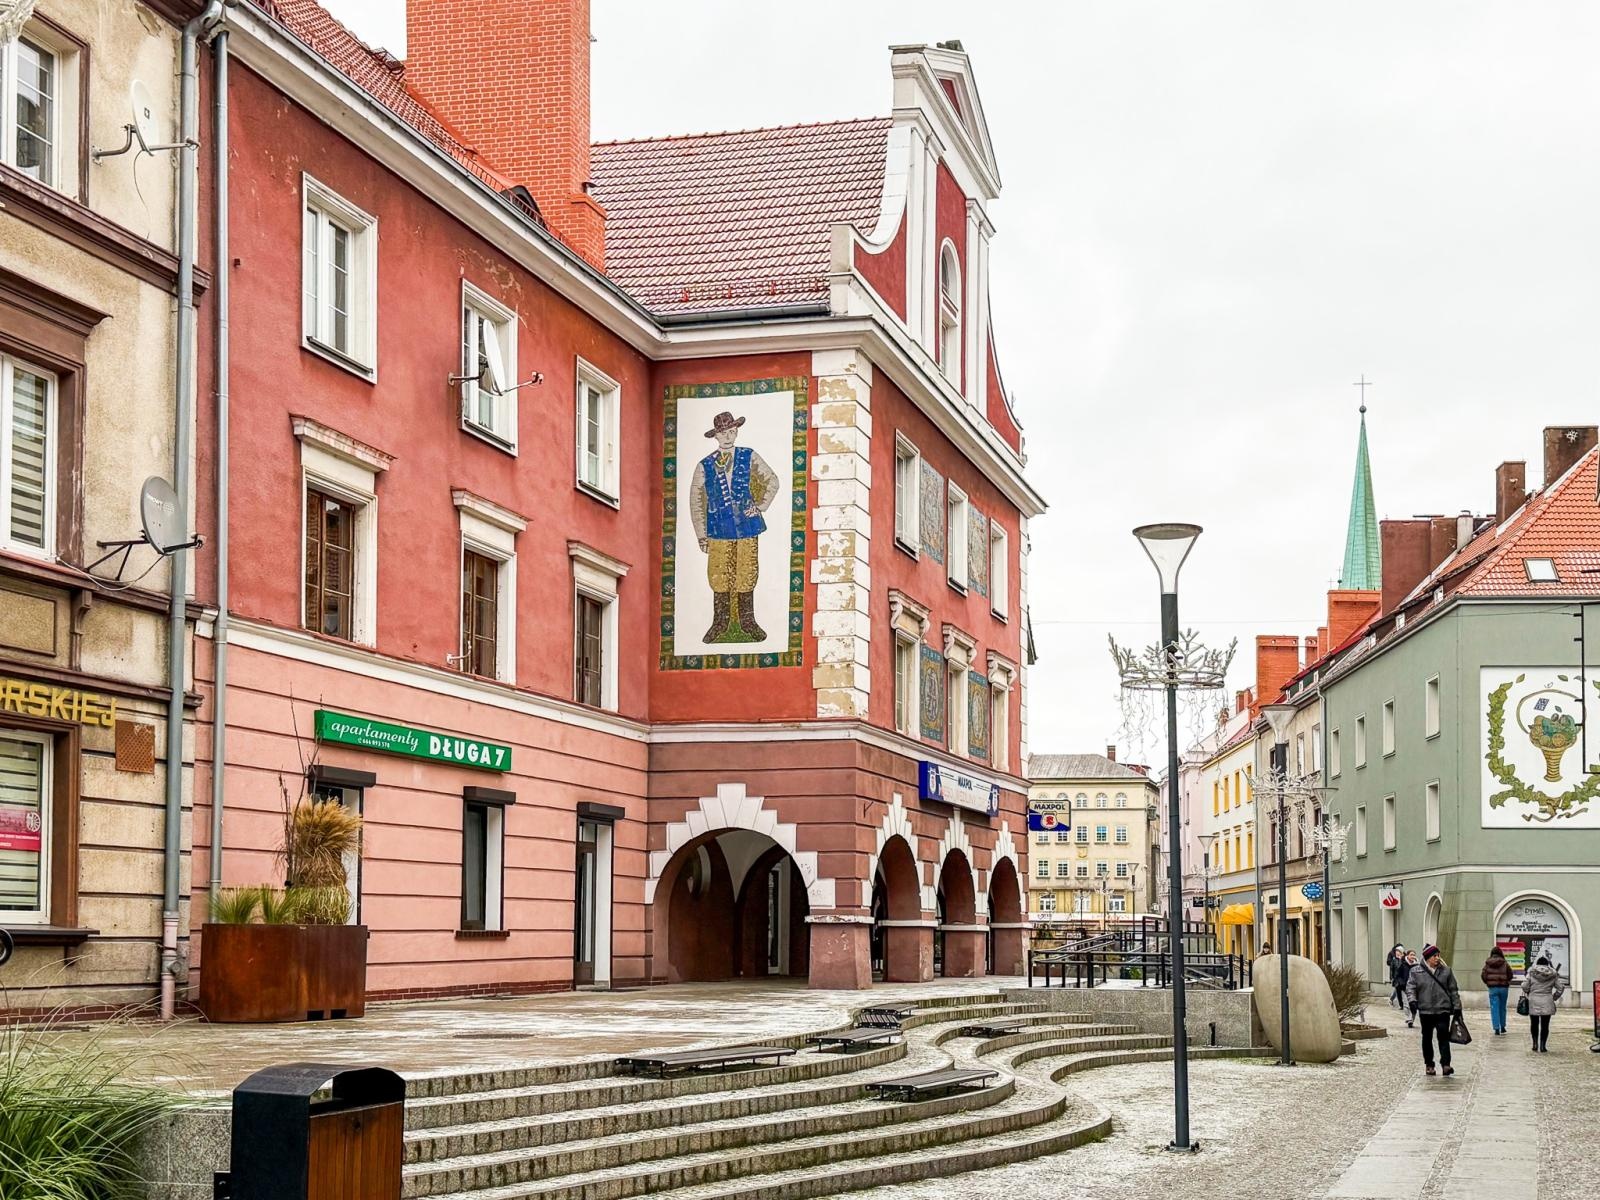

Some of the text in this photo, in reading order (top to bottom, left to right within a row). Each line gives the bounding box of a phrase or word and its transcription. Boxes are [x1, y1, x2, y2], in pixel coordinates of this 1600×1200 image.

[331, 722, 419, 752] apartamenty
[429, 735, 505, 767] DŁUGA 7
[1034, 803, 1066, 811] MAXPOL
